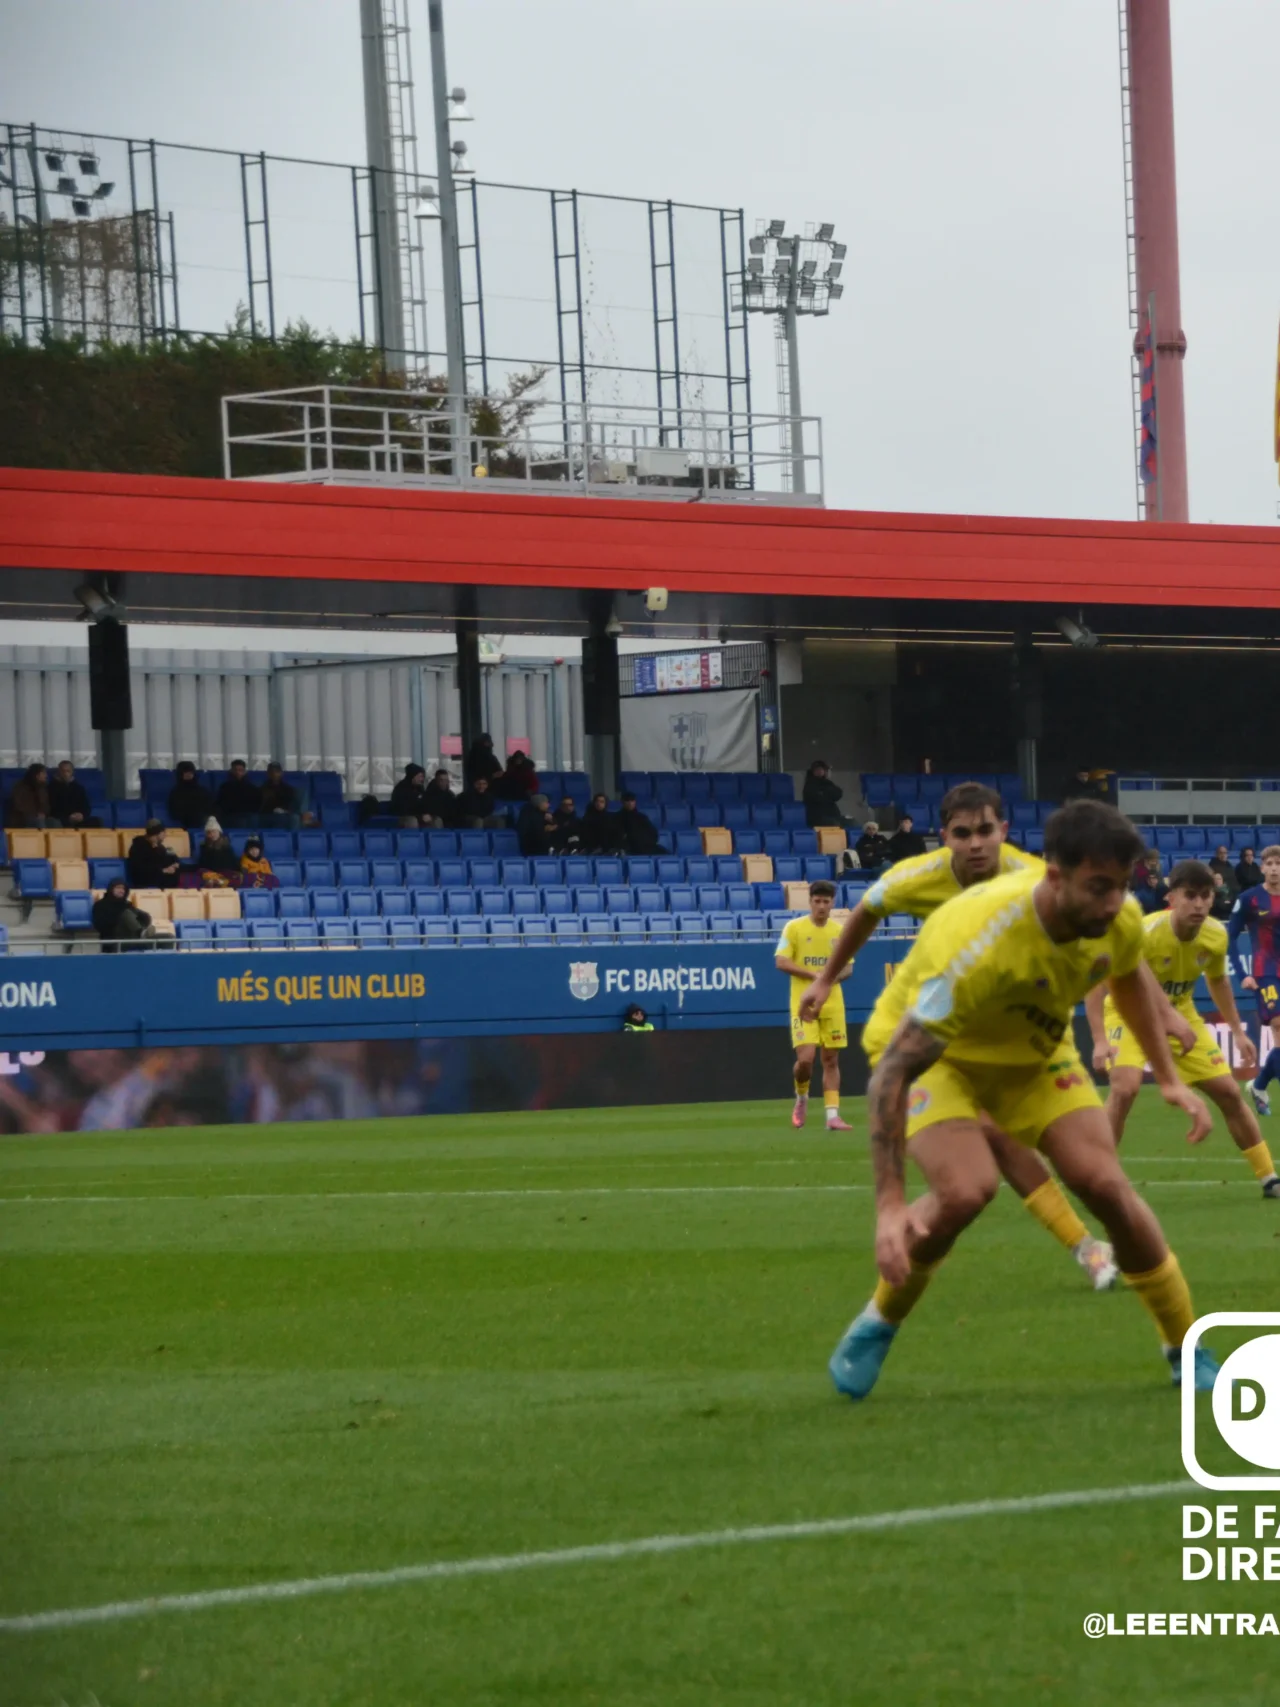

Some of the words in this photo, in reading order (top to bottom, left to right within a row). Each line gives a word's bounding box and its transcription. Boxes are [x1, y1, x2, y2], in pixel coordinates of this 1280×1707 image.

[218, 970, 269, 1002] MÉS
[275, 976, 322, 1005] QUE
[328, 975, 361, 999] UN
[367, 974, 425, 998] CLUB
[606, 969, 630, 992] FC
[634, 967, 756, 992] BARCELONA
[0, 982, 57, 1008] ONA
[1261, 985, 1278, 1002] 14
